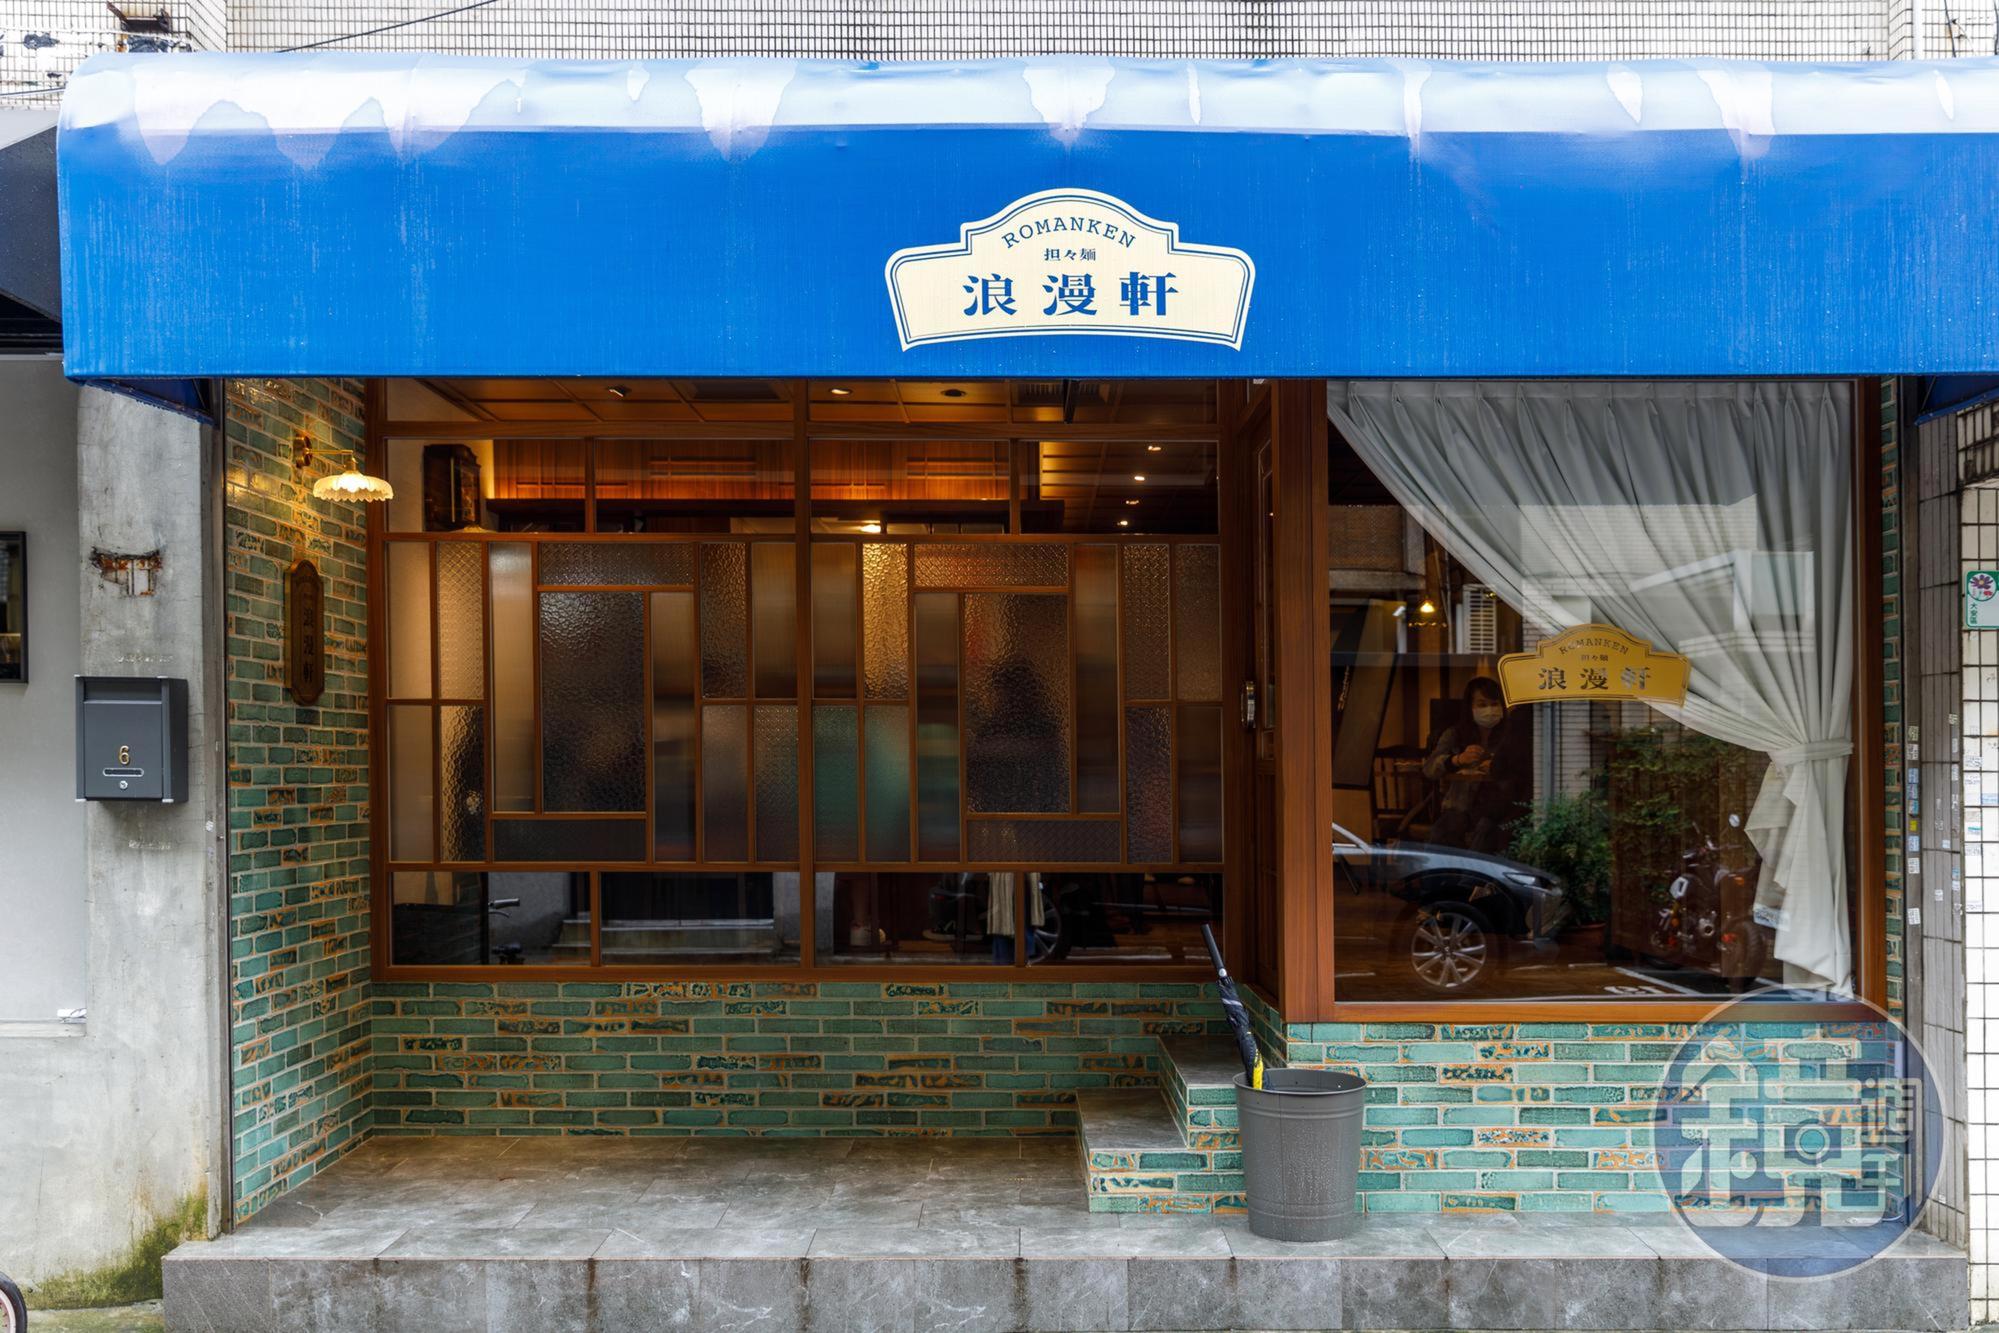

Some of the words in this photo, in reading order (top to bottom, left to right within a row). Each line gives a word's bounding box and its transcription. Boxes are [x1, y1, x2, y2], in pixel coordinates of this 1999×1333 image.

[1002, 216, 1136, 248] ROMANKEN
[962, 271, 1179, 316] 浪漫軒
[119, 745, 130, 764] 6
